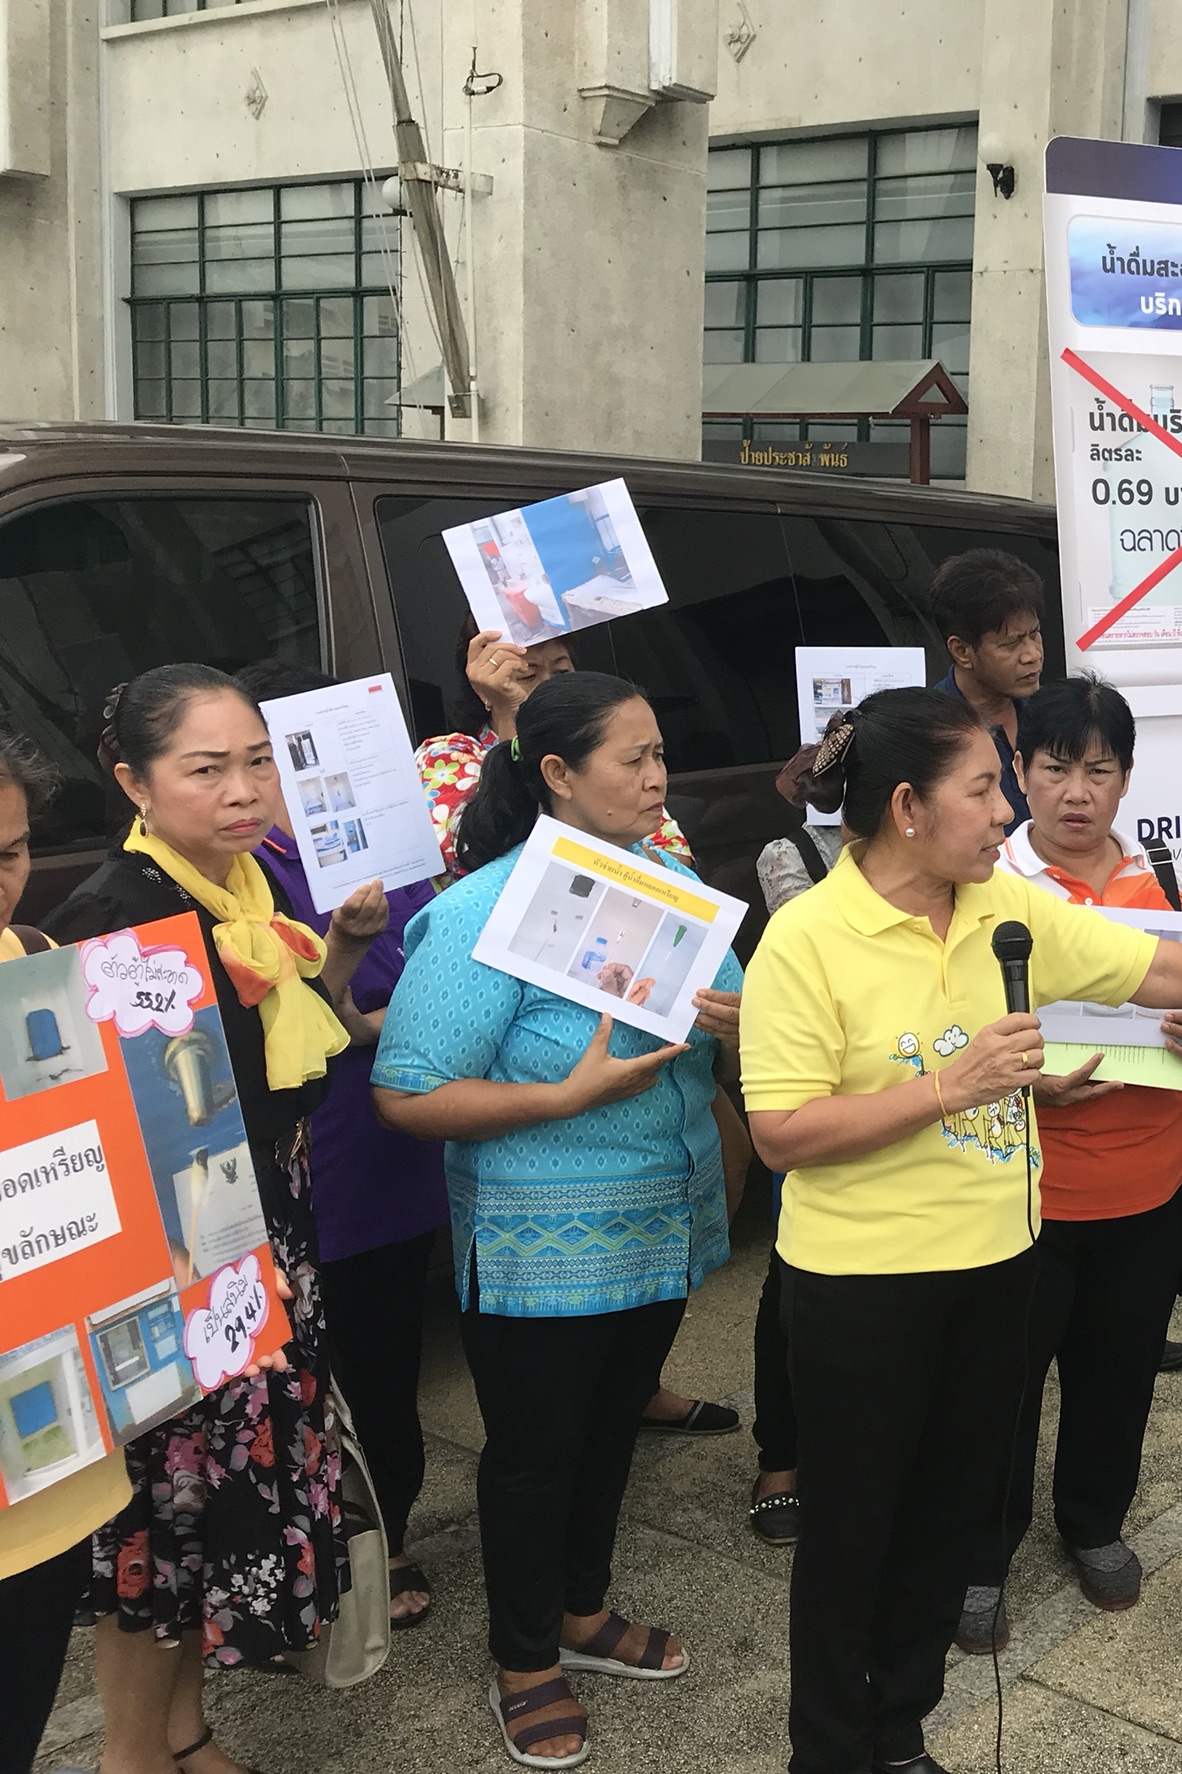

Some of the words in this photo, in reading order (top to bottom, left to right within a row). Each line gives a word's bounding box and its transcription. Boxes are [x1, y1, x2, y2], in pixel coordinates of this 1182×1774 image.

[1089, 443, 1142, 463] ลิตรละ
[1091, 478, 1154, 507] 0.69
[0, 1145, 105, 1200] อดเหรียญ
[0, 1213, 99, 1280] ขลักษณะ
